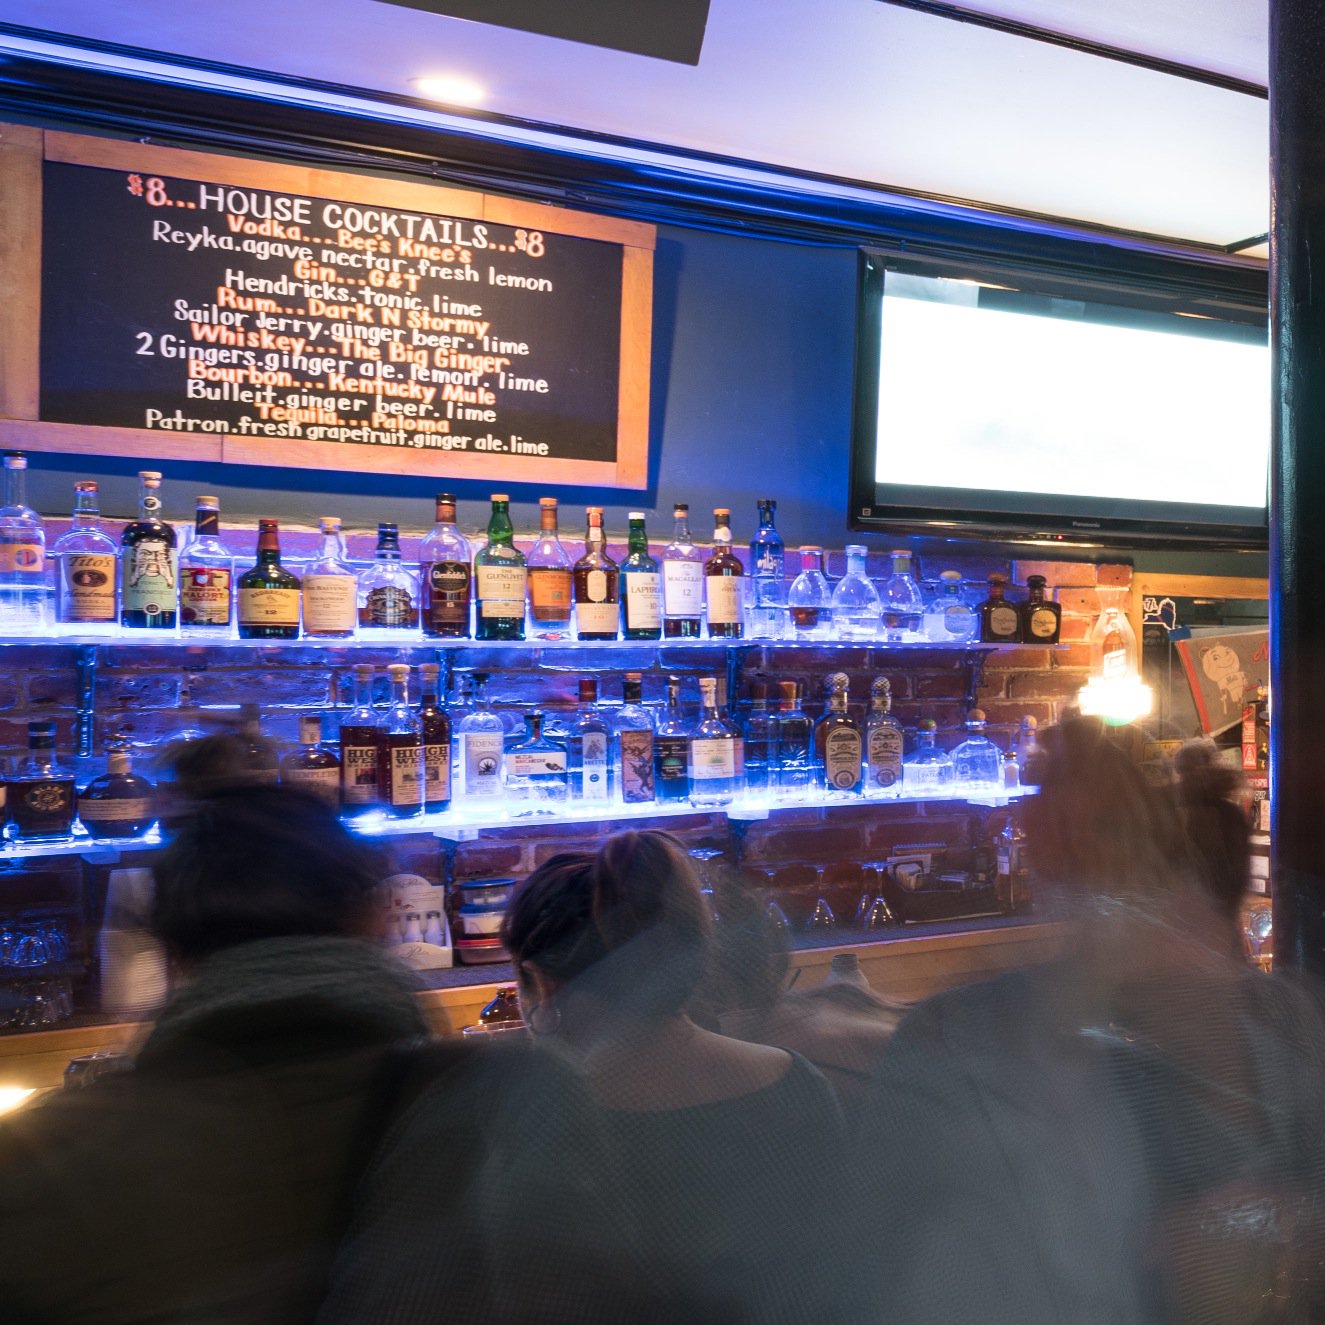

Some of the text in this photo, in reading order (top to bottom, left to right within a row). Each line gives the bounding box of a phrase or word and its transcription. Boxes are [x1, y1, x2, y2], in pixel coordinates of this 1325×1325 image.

[398, 237, 473, 265] Knee's
[489, 266, 553, 292] lemon
[174, 299, 249, 327] Sailor
[483, 336, 530, 355] lime
[381, 307, 400, 327] N
[406, 310, 491, 340] Stormy
[135, 332, 155, 356] 2
[499, 372, 550, 394] lime
[388, 342, 429, 368] Big
[434, 348, 511, 376] Ginger
[441, 384, 496, 406] Mule
[447, 401, 497, 423] lime
[69, 555, 113, 568] Tito's
